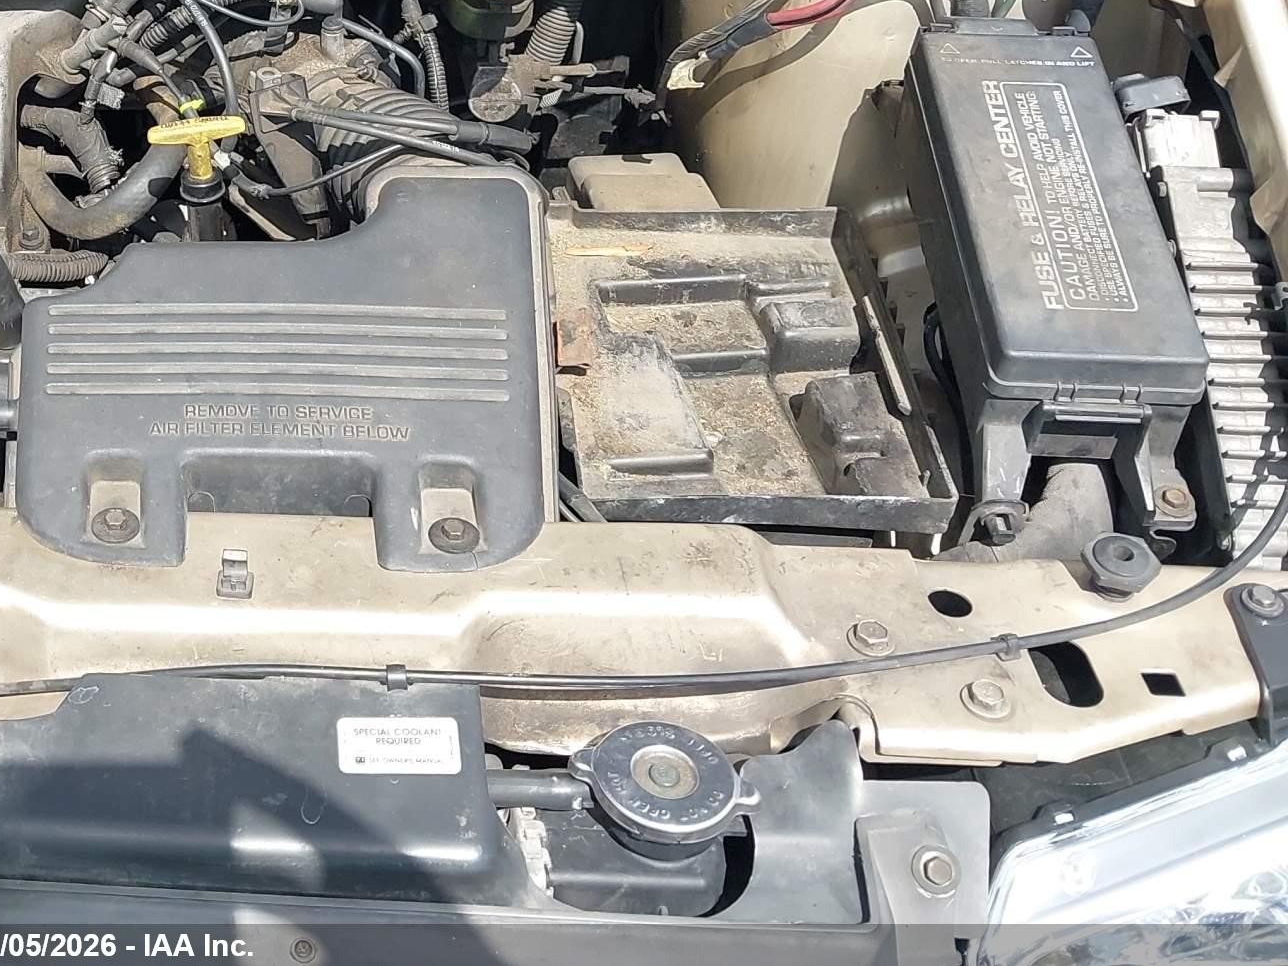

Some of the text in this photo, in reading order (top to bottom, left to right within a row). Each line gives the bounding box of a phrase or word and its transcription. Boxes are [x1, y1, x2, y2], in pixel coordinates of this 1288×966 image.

[1053, 90, 1068, 115] COVER
[1061, 115, 1073, 132] THIS
[1041, 142, 1057, 162] NOT
[1062, 152, 1078, 171] ONLY
[1067, 133, 1087, 174] RE-INSTALL
[982, 80, 1064, 309] FUSE & RELAY CENTER
[1015, 92, 1086, 300] CAUTION! TO HELP AVOID VEHICLE
[1048, 165, 1069, 204] ENGINE
[1072, 172, 1089, 201] RELAYS
[1081, 175, 1101, 215] PROPERLY
[1052, 138, 1109, 295] DISCONNECT BATTERY BEFORE SERVICING
[1062, 206, 1085, 251] AND/OR
[1084, 211, 1100, 237] FUSES
[1099, 227, 1112, 249] SURE
[1093, 237, 1113, 278] SPECIFIED
[1076, 253, 1100, 301] DAMAGE
[1107, 280, 1119, 296] USE
[1110, 262, 1128, 296] ALWAYS
[184, 403, 374, 421] REMOVE TO SERVICE
[149, 421, 410, 441] AIR FILTER ELEMENT BELOW
[353, 728, 442, 737] SPECIAL COOLANT
[630, 798, 672, 821] OPEN
